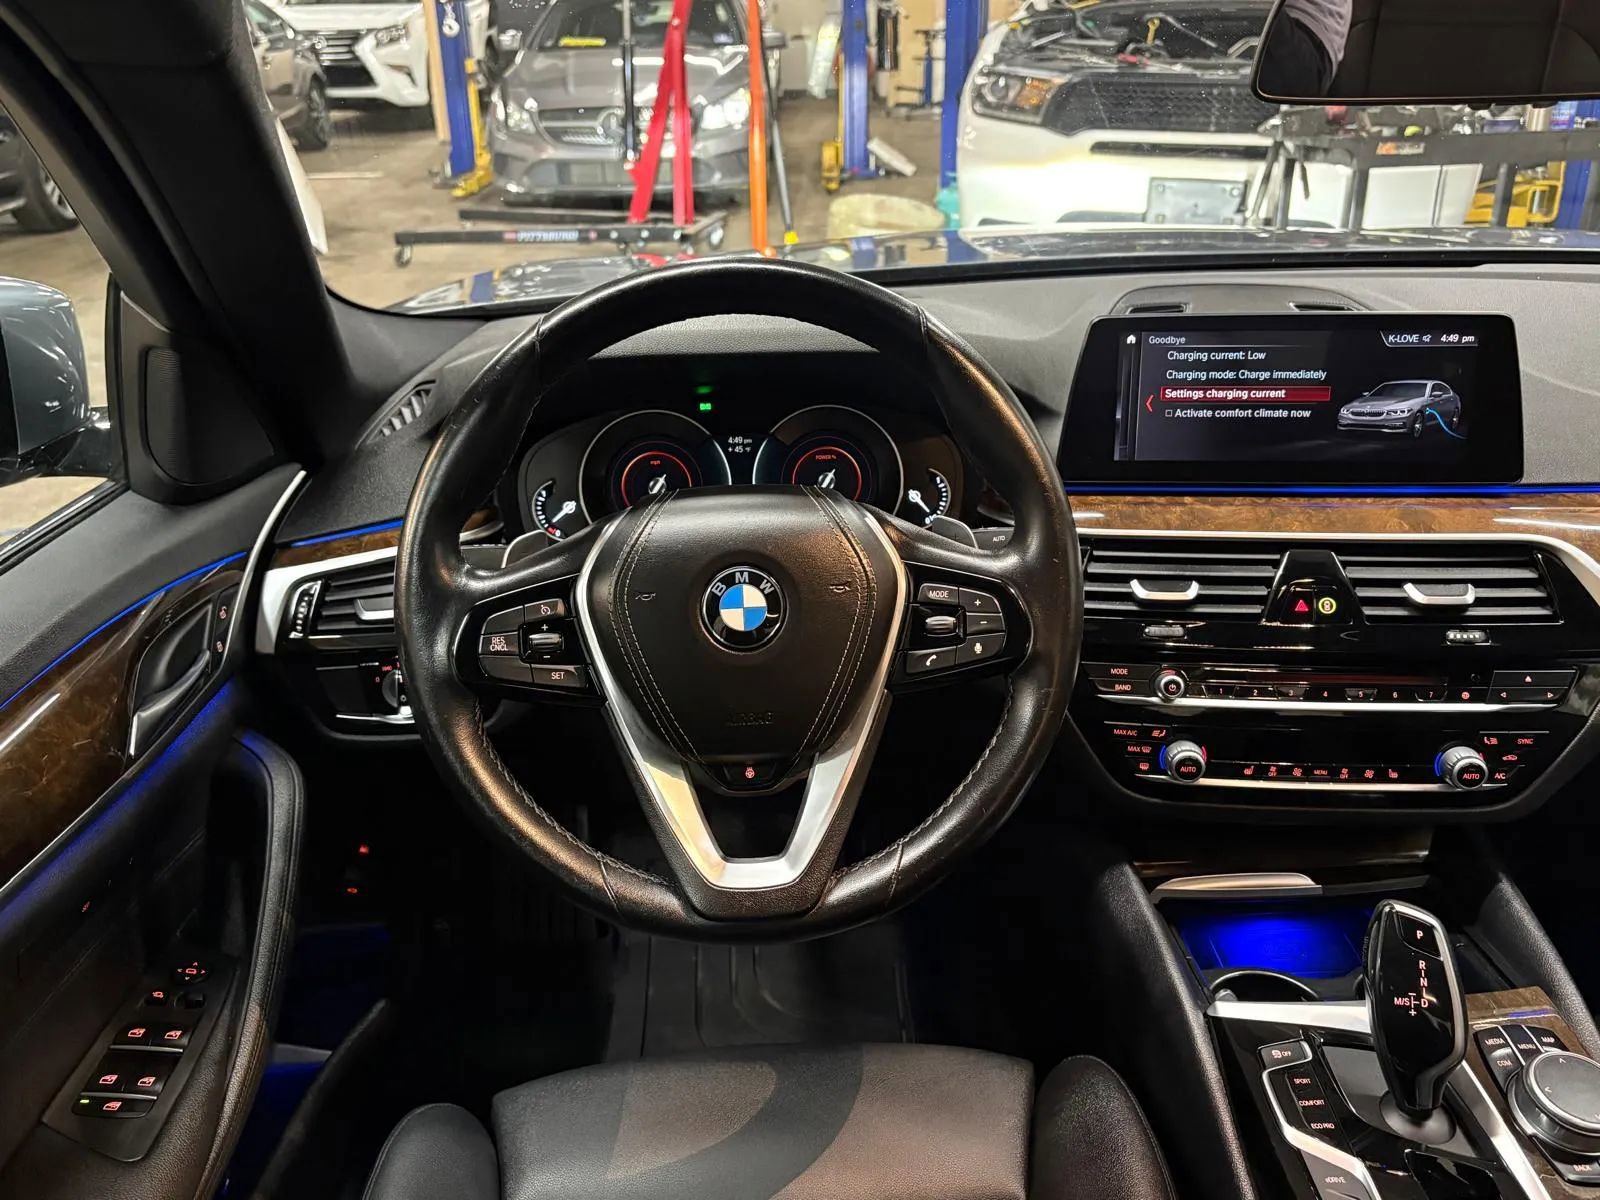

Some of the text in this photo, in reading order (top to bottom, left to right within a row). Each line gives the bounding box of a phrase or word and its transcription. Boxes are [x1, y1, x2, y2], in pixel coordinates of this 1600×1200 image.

[1149, 336, 1186, 345] Goodbye
[1388, 334, 1420, 343] K-LOVE
[1440, 334, 1475, 343] 4:49 pm
[1167, 351, 1266, 361] Charging current: Low
[1166, 370, 1327, 380] Charging mode: Charge immediately
[1165, 389, 1286, 399] Settings charging current
[1174, 409, 1312, 418] Activate comfort climate now
[728, 436, 743, 444] 4:49
[712, 571, 775, 597] BMW
[929, 590, 949, 599] MODE
[491, 636, 505, 645] RES
[490, 643, 508, 652] CNCL
[551, 672, 565, 680] SET
[1110, 668, 1129, 676] MODE
[1114, 683, 1132, 691] BAND
[1180, 765, 1197, 773] AUTO
[1416, 930, 1424, 939] P
[1418, 960, 1426, 970] R
[1420, 977, 1428, 987] N
[1393, 997, 1429, 1008] M/S D
[1484, 1037, 1506, 1046] MEDIA
[1497, 1059, 1513, 1067] COM
[1298, 1099, 1325, 1107] COMFORT
